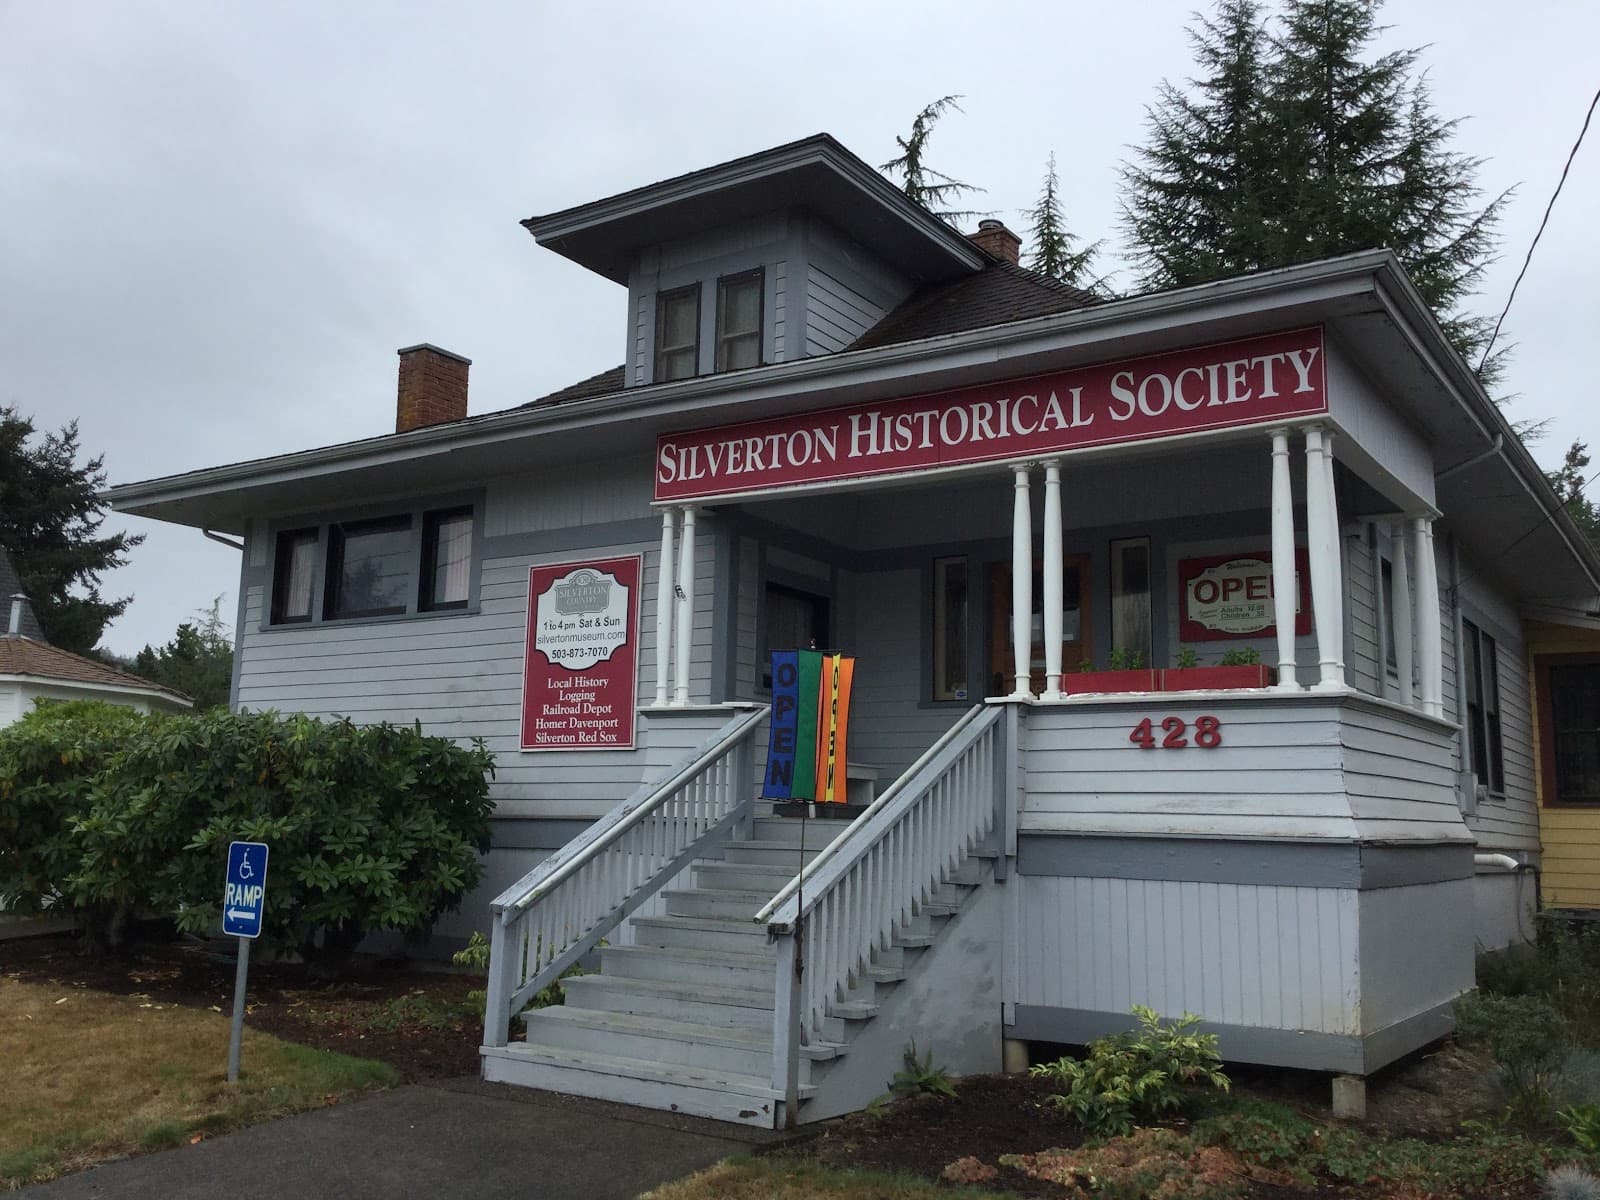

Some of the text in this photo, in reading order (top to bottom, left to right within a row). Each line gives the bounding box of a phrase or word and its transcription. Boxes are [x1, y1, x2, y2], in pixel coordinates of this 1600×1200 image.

[659, 347, 1320, 484] SILVERTON HISTORICAL SOCIETY
[1193, 575, 1275, 604] OPE
[549, 621, 557, 631] to
[558, 620, 564, 630] 4
[564, 622, 576, 632] pm
[579, 618, 593, 629] Sat
[594, 618, 601, 627] &
[603, 616, 620, 627] Sun
[537, 630, 626, 645] silvertonmuseum.com
[551, 646, 608, 660] 503-873-7070
[547, 676, 609, 689] Local History
[559, 690, 596, 704] Logging
[543, 703, 612, 716] Railroad Depot
[535, 717, 619, 730] Homer Davenport
[770, 663, 797, 786] OPEN
[535, 731, 617, 744] Silverton Red Sox
[1129, 715, 1222, 749] 428
[226, 882, 263, 908] RAMP
